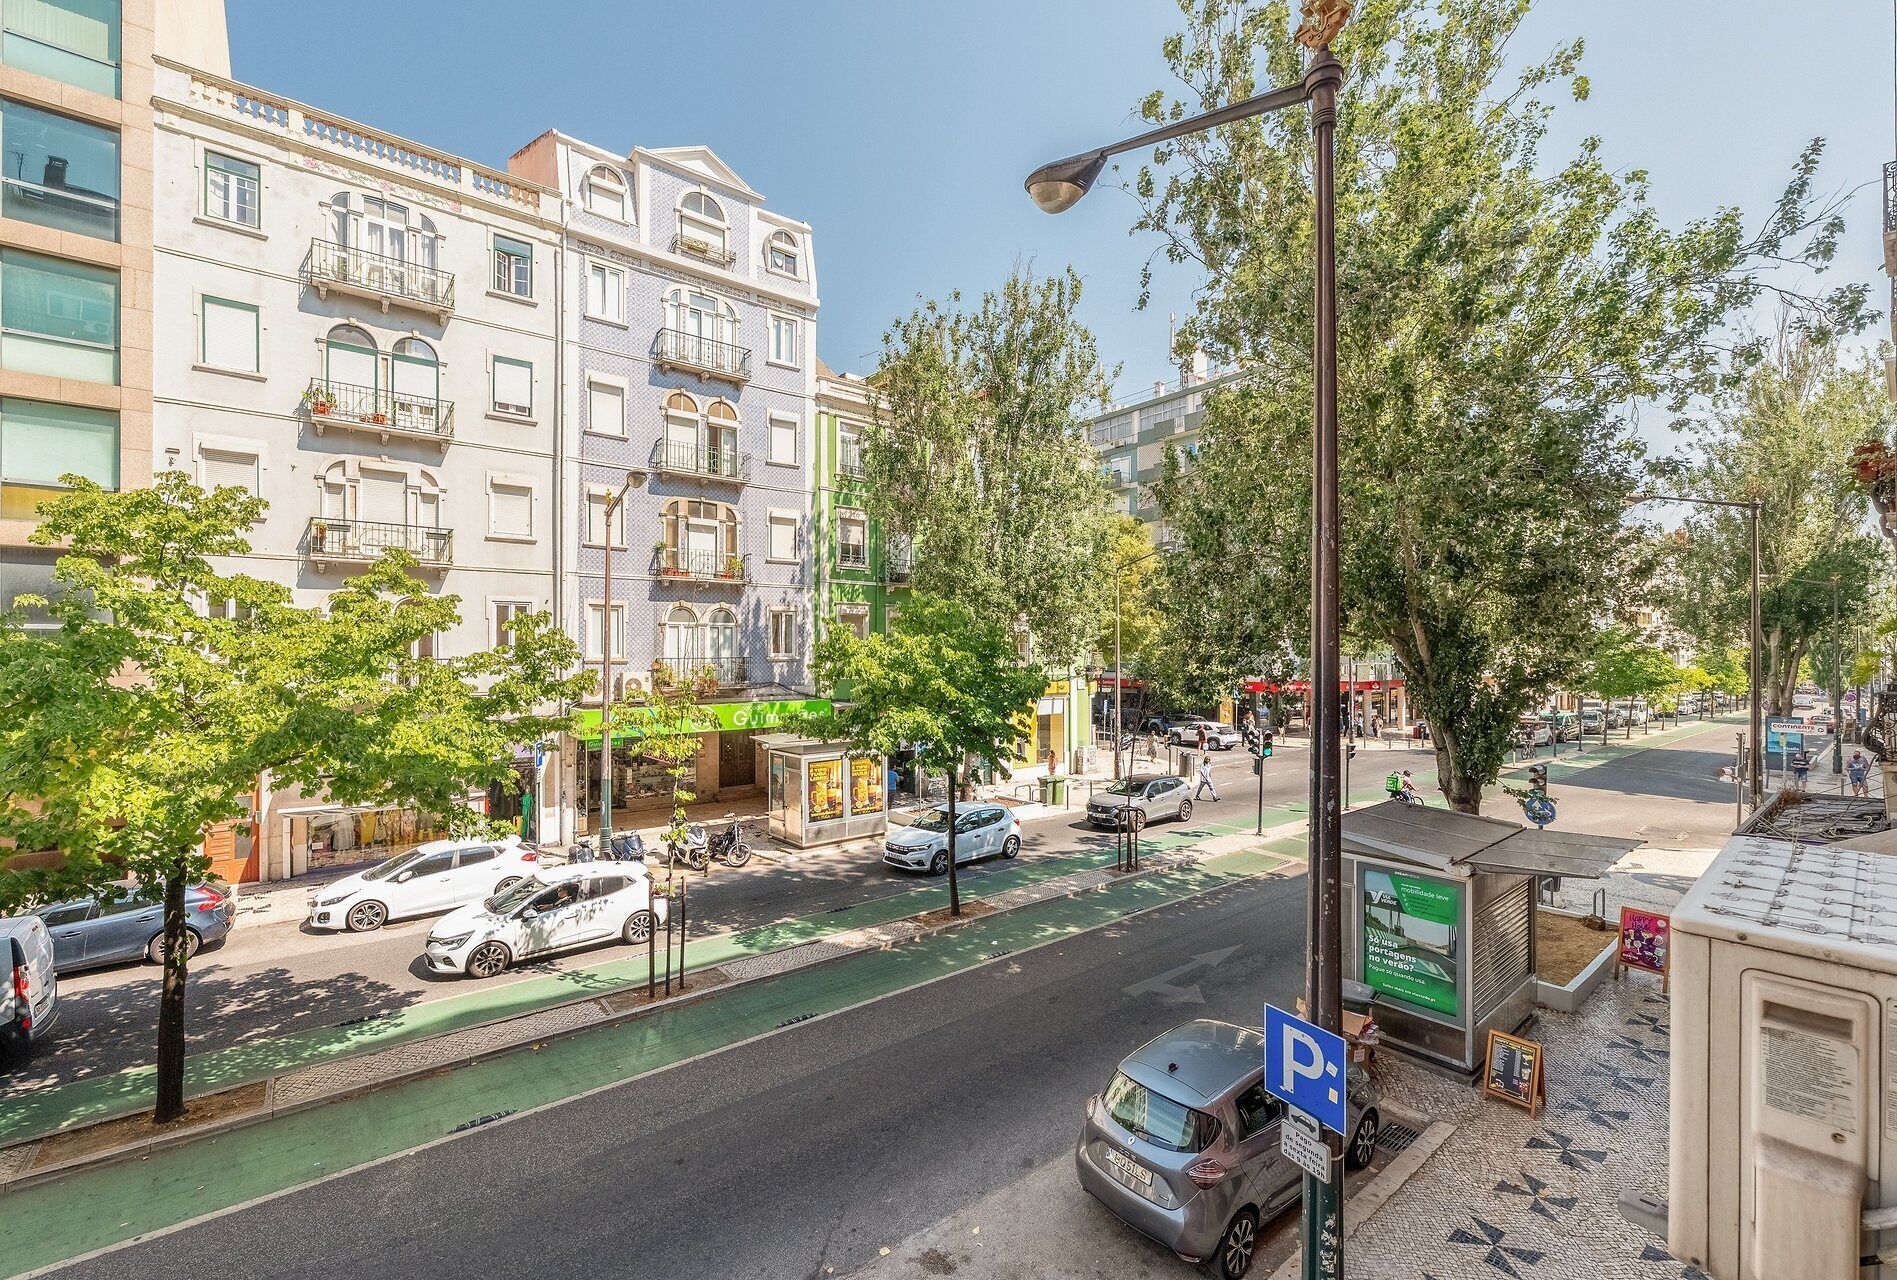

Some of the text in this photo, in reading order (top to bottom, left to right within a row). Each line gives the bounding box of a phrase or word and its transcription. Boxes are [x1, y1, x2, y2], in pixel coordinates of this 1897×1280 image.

[733, 708, 825, 726] Guimães
[1772, 723, 1816, 731] CONTINENTE
[1381, 898, 1397, 906] VERDE
[1400, 887, 1435, 899] mobilidade
[1436, 893, 1449, 902] leve
[1629, 914, 1653, 925] HAPPY
[1368, 934, 1398, 948] Só usa
[1368, 945, 1417, 963] portagens
[1368, 954, 1415, 972] no verão?
[1368, 963, 1385, 973] Pague
[1393, 971, 1414, 981] quando
[1282, 1023, 1325, 1094] P
[1285, 1134, 1323, 1162] de segunda
[1295, 1132, 1312, 1147] Pago
[1283, 1148, 1295, 1159] das
[1312, 1167, 1325, 1180] 19h
[1289, 1145, 1307, 1160] sexta
[1309, 1156, 1325, 1171] feira
